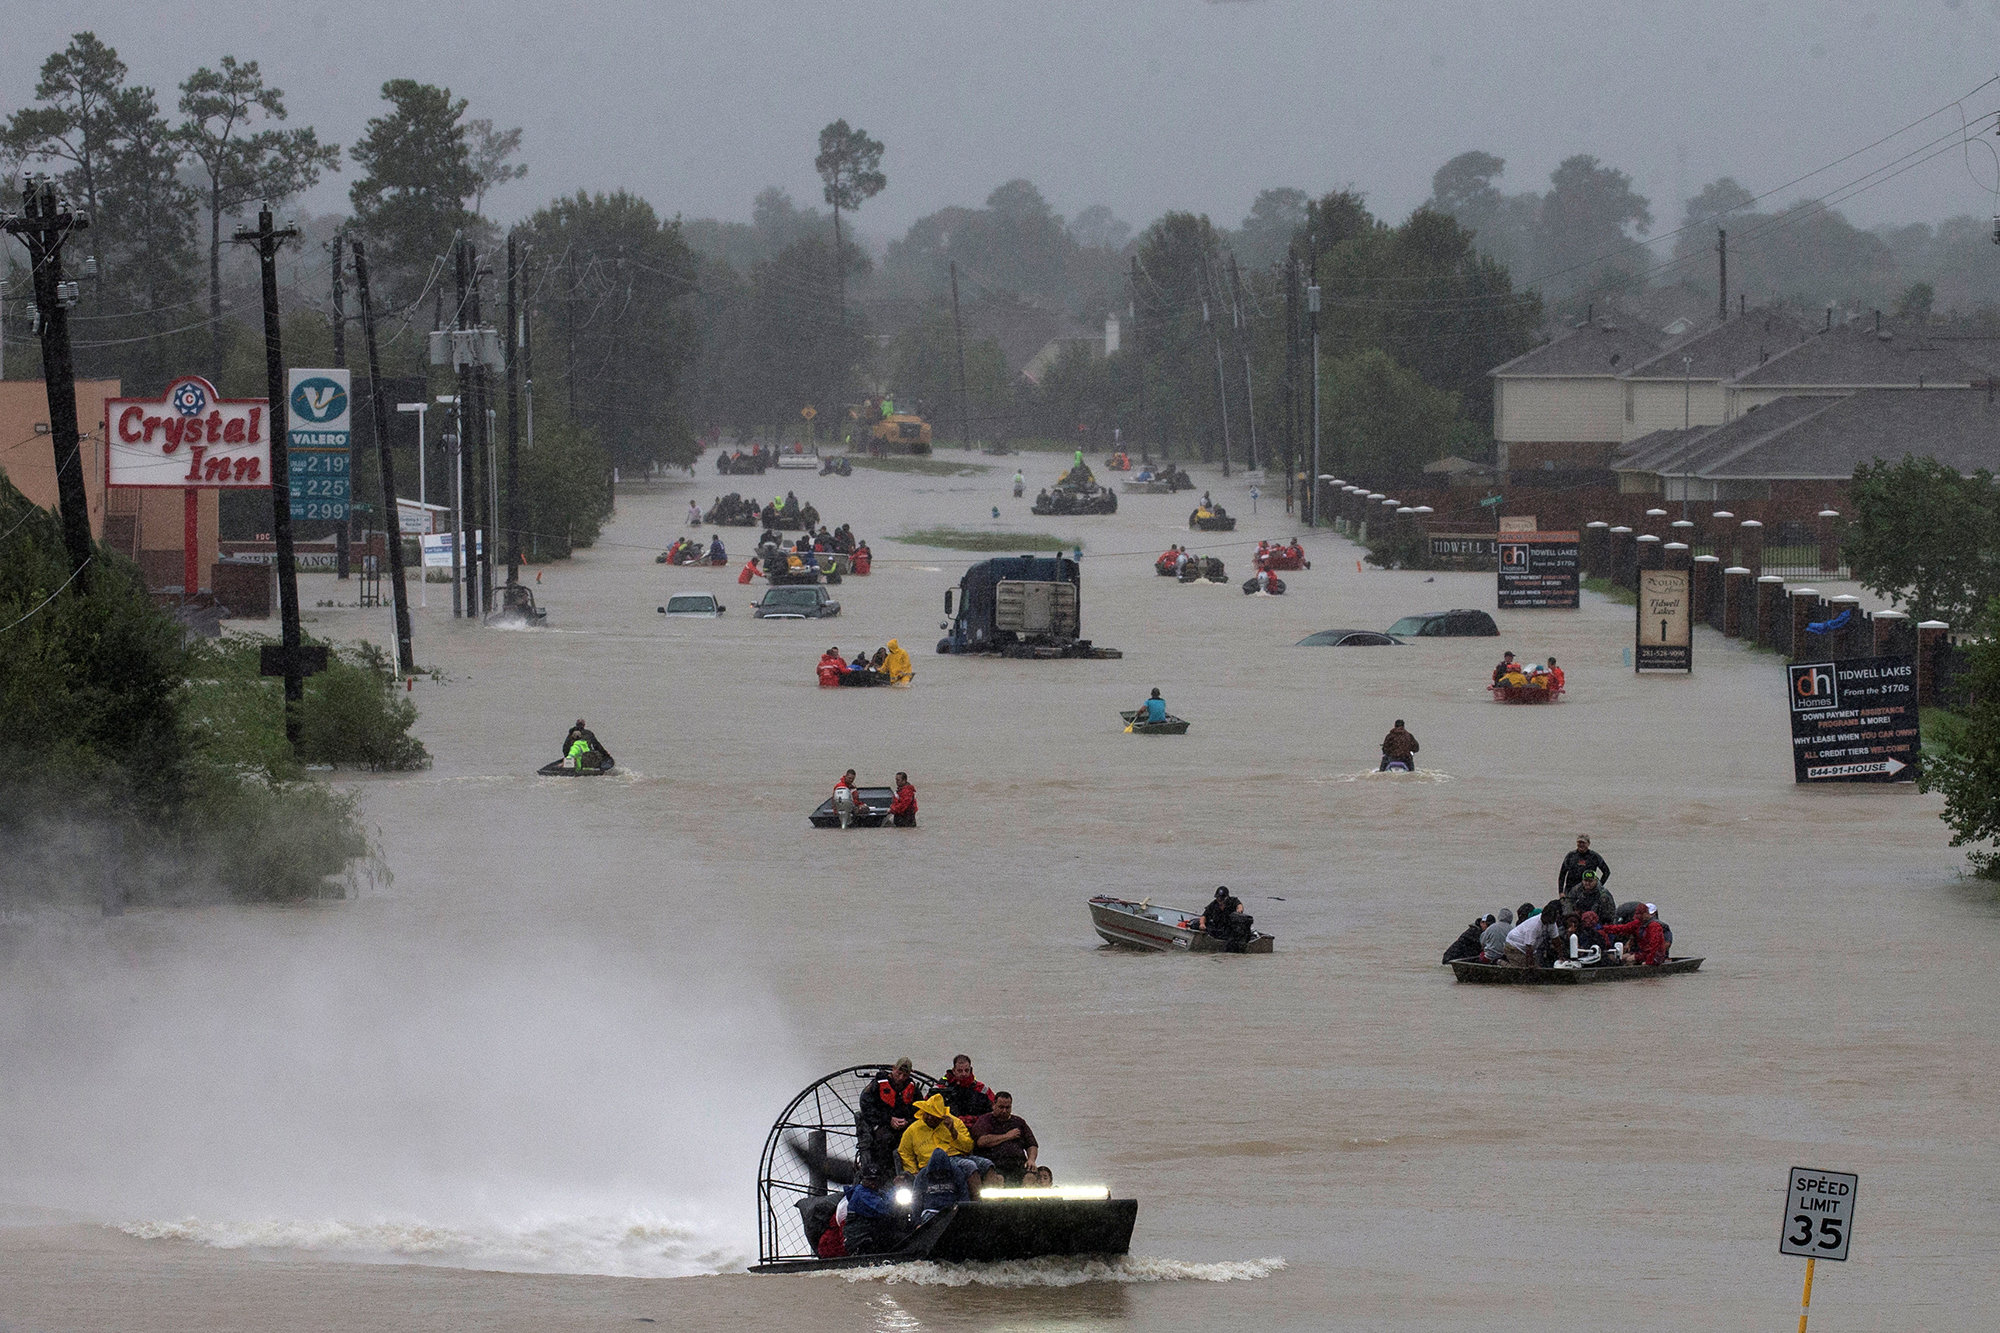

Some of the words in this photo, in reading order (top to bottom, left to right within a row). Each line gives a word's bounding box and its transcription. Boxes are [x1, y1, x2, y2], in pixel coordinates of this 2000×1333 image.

[186, 394, 192, 403] C
[119, 406, 261, 453] Crystal
[292, 434, 346, 444] VALERO
[184, 446, 261, 481] Inn
[1504, 546, 1525, 564] dh
[1650, 599, 1680, 607] Tidwell
[1653, 607, 1675, 615] Lakes
[1839, 669, 1878, 680] TIDWELL
[1881, 666, 1912, 677] LAKES
[1798, 668, 1830, 696] dh
[1844, 688, 1864, 696] From
[1881, 684, 1910, 694] $170s
[1798, 698, 1832, 707] Homes
[1803, 712, 1825, 720] DOWN
[1826, 710, 1859, 719] PAYMENT
[1812, 734, 1836, 744] LEASE
[1838, 733, 1859, 741] WHEN
[1820, 749, 1847, 758] CREDIT
[1810, 763, 1886, 776] 844-91-HOUSE
[1796, 1178, 1849, 1196] SPEED
[1800, 1197, 1840, 1213] LIMIT
[1789, 1215, 1842, 1250] 35
